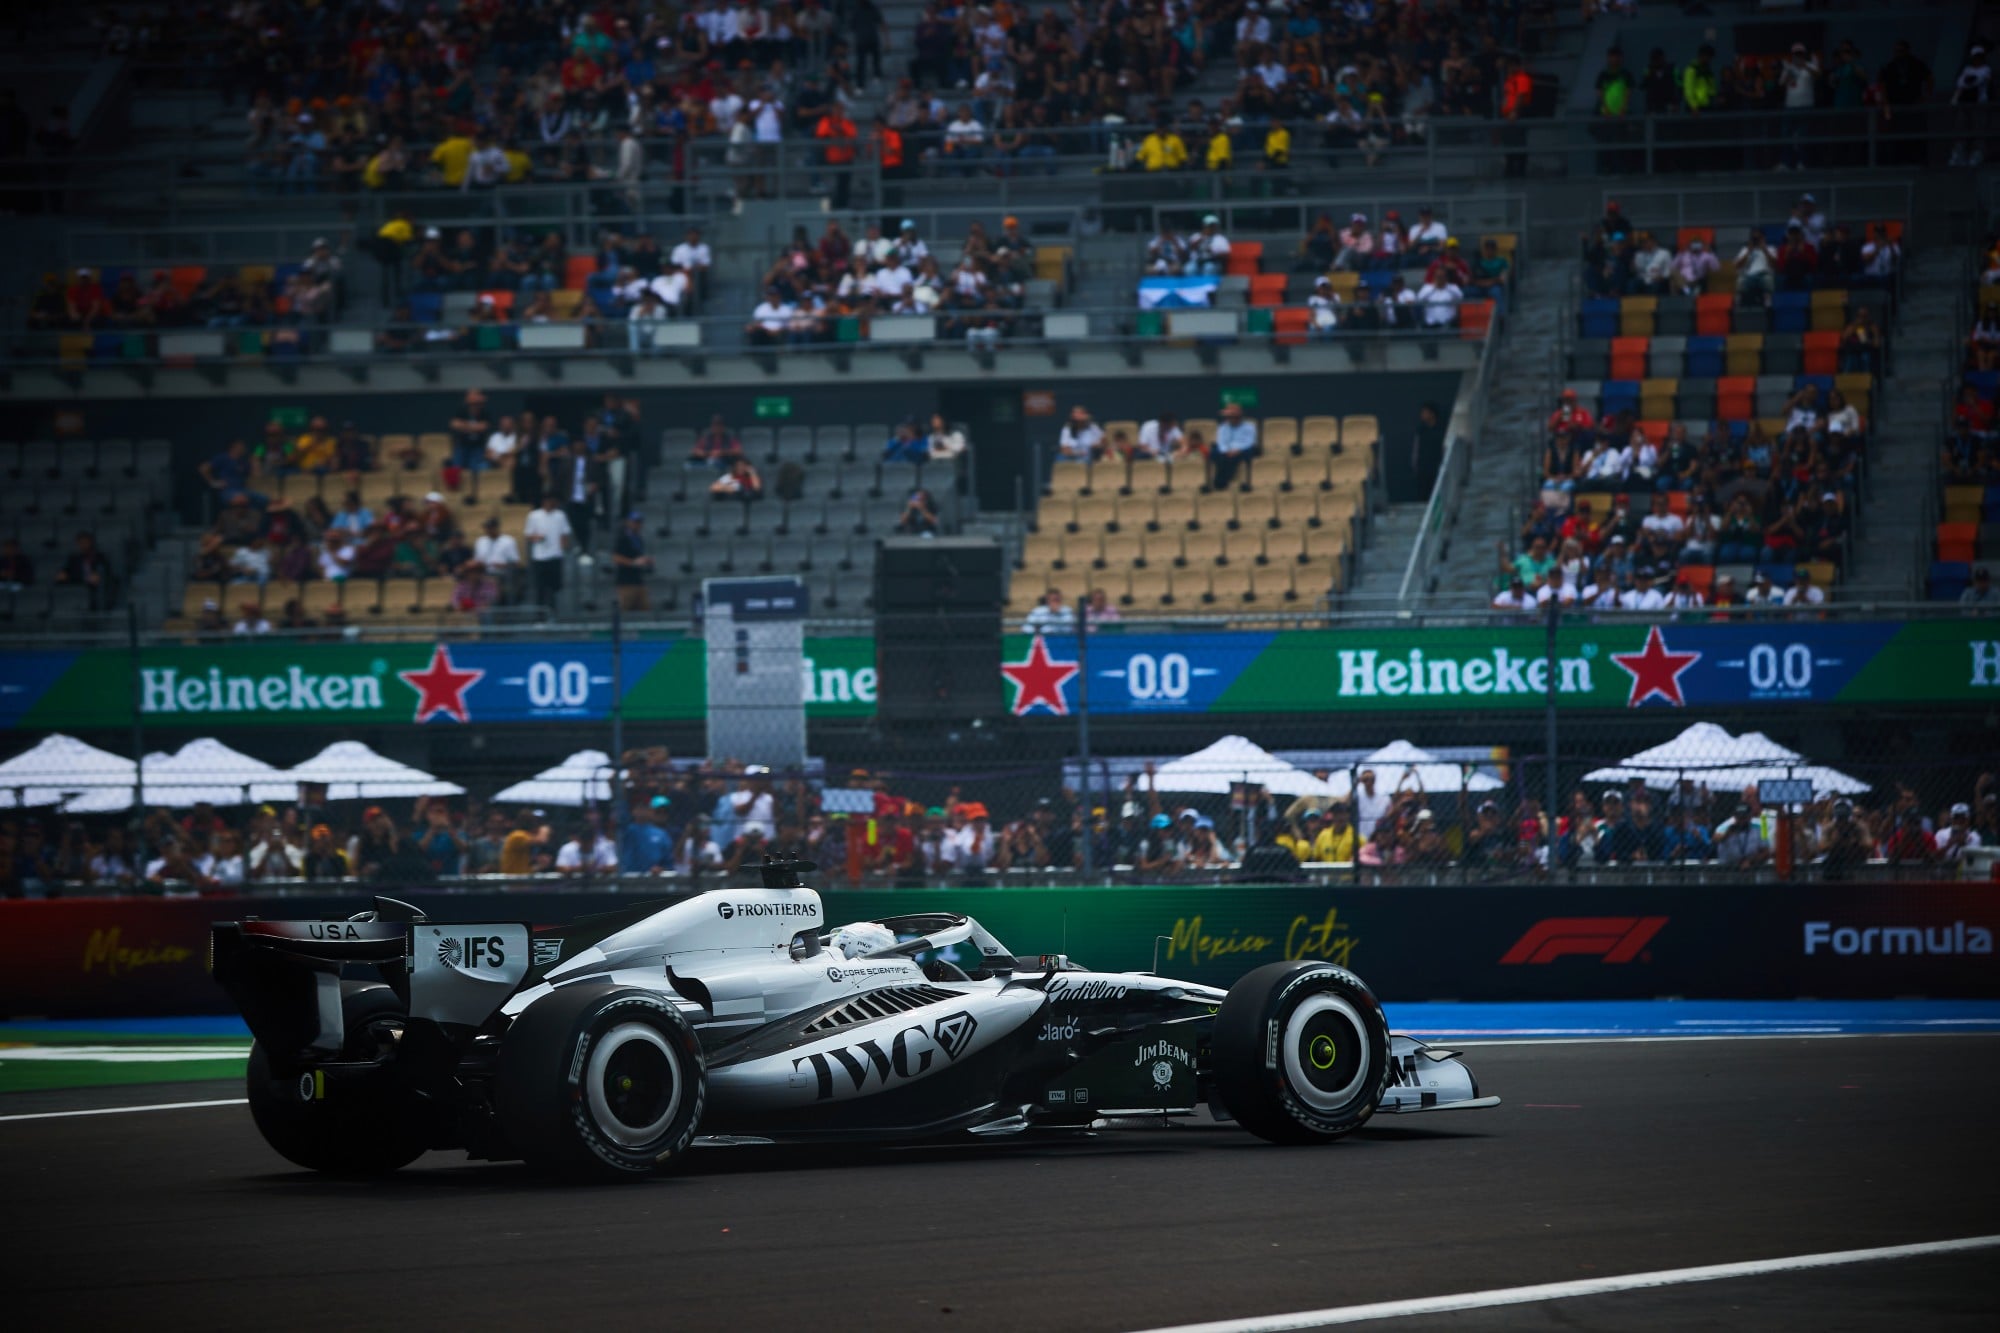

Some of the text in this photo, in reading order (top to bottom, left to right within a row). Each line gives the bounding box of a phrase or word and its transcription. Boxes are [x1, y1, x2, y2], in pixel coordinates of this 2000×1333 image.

[527, 660, 589, 707] 0.0
[1127, 652, 1190, 699] 0.0
[1337, 647, 1594, 696] Heineken
[1748, 642, 1811, 690] 0.0
[139, 665, 384, 712] Heineken
[737, 903, 817, 917] FRONTIERAS
[309, 924, 361, 940] USA
[464, 936, 505, 969] IFS
[1166, 906, 1360, 969] Mexico City
[1804, 920, 1993, 955] Formula
[843, 968, 865, 977] CORE
[1044, 977, 1129, 1004] Cadillac
[792, 1024, 936, 1100] TWG
[1134, 1039, 1190, 1067] JIM BEAM
